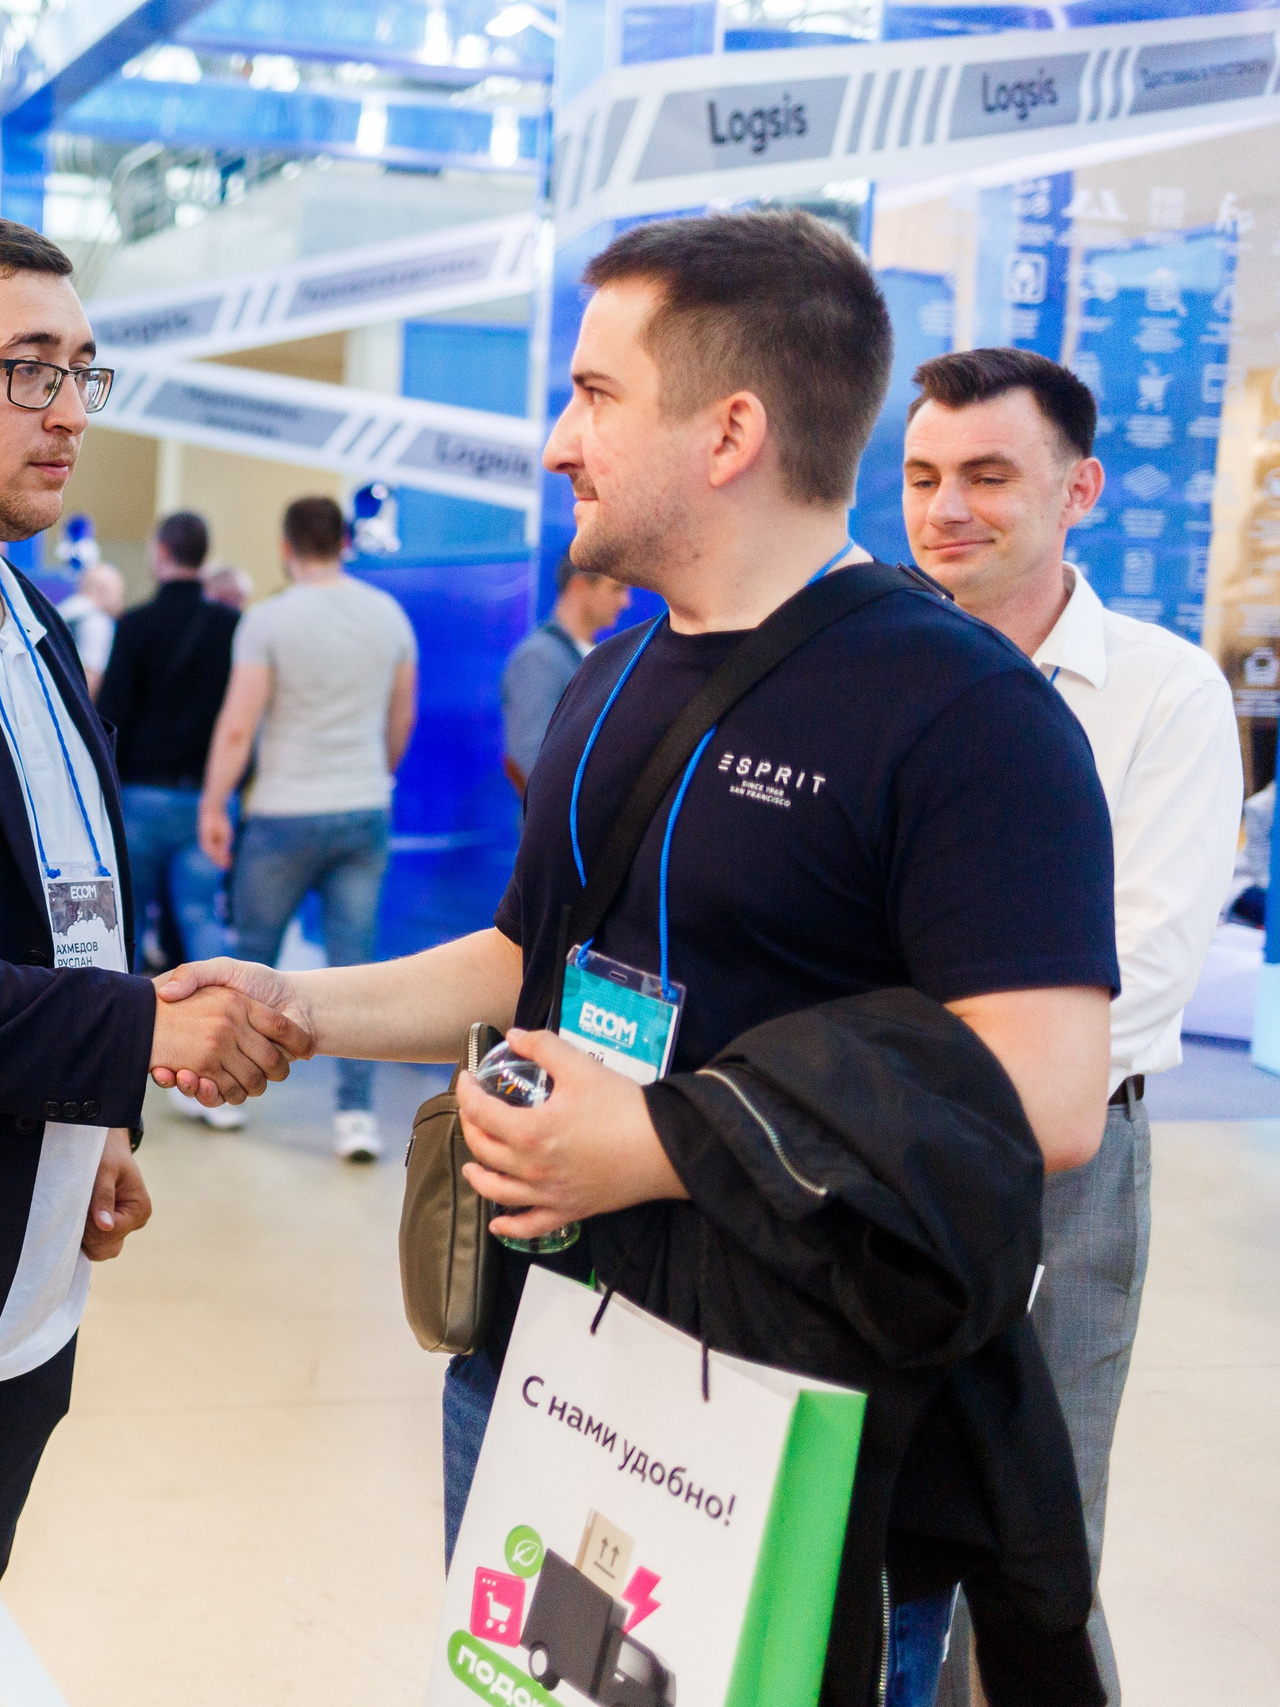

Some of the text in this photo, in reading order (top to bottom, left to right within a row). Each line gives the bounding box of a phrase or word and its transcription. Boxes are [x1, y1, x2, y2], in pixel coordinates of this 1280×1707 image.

[981, 69, 1059, 121] Logsis
[706, 91, 808, 155] Logsis
[718, 753, 827, 794] ESPRIT
[742, 780, 785, 797] SINCE 1968
[729, 785, 791, 807] SAN FRANCISCO
[70, 884, 98, 900] ECOM
[56, 941, 99, 955] АХМЕДОВ
[57, 956, 93, 968] РУСЛАН
[579, 1001, 638, 1047] ECOM
[522, 1375, 737, 1527] С нами удобно!
